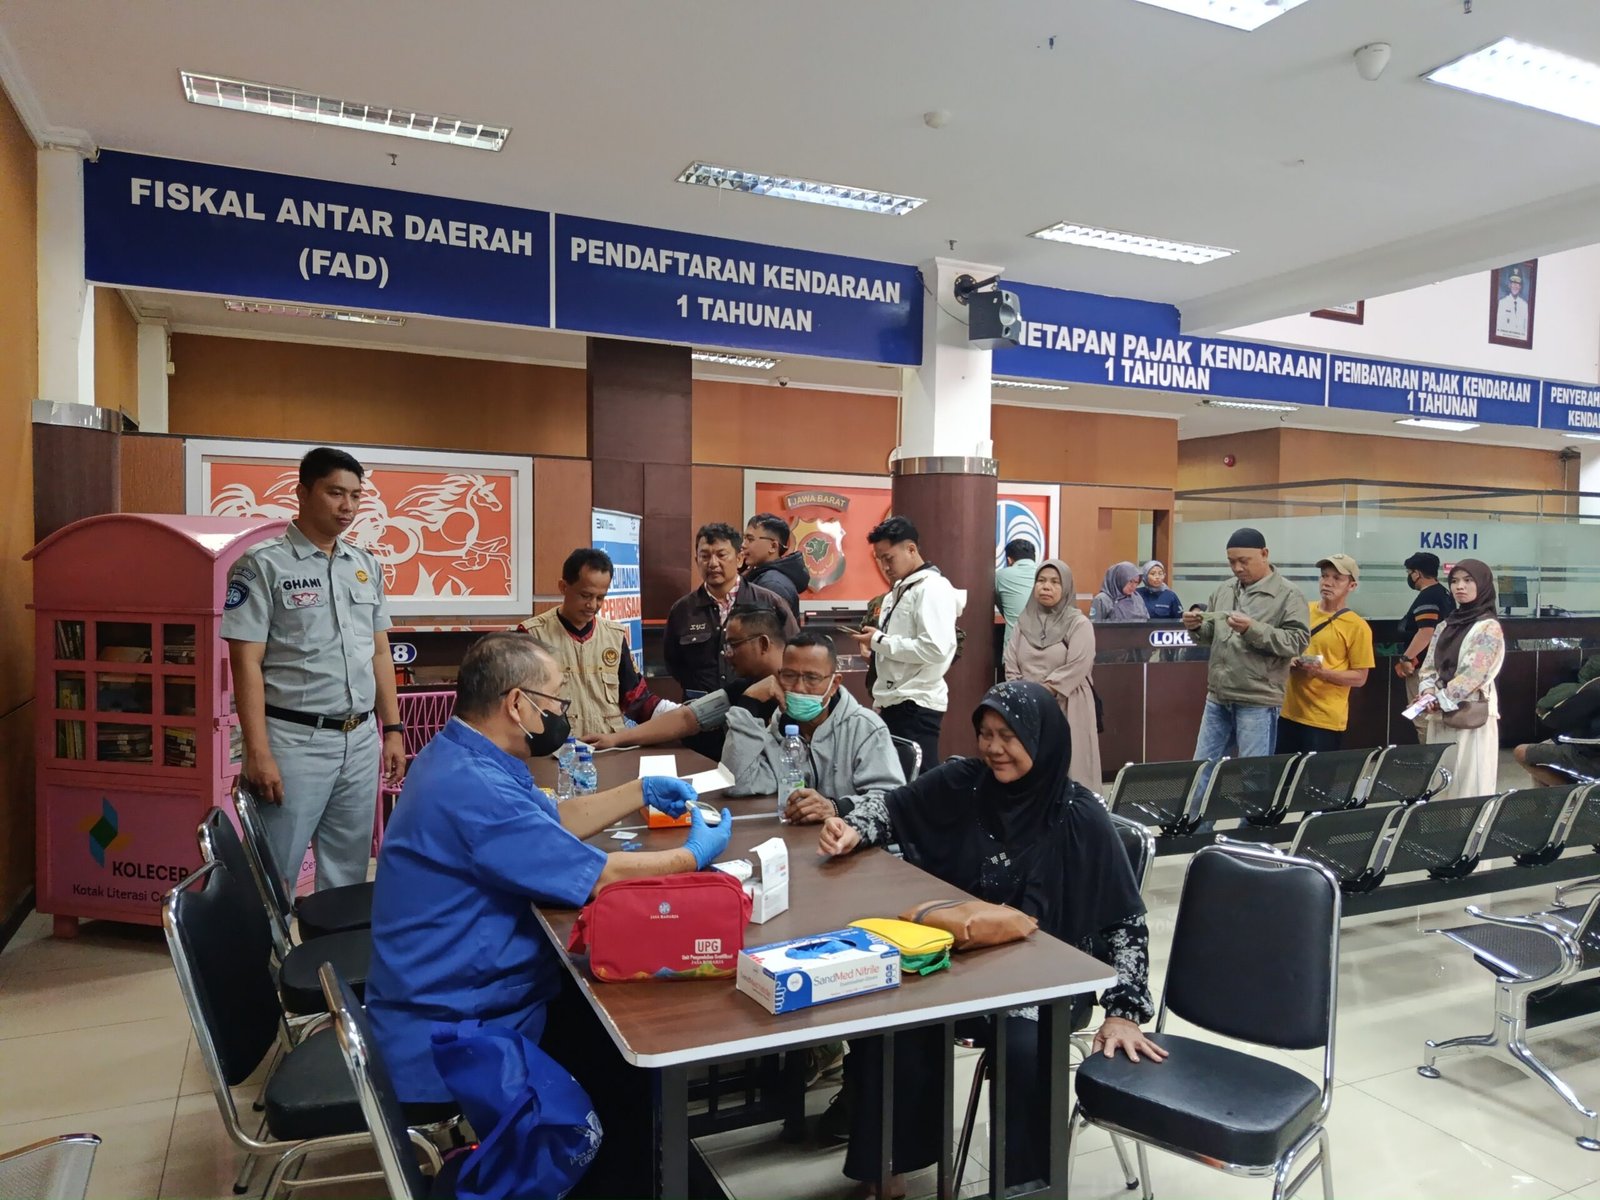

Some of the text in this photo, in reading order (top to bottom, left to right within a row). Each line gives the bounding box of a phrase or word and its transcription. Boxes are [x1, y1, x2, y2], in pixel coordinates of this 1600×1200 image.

[130, 177, 533, 256] FISKAL ANTAR DAERAH
[299, 248, 390, 289] (FAD)
[570, 236, 901, 304] PENDAFTARAN KENDARAAN
[676, 294, 812, 333] 1 TAHUNAN
[1123, 334, 1192, 365] PAJAK
[1200, 343, 1322, 380] KENDARAAN
[1104, 357, 1210, 391] 1 TAHUNAN
[1334, 360, 1531, 403] PEMBAYARAN PAJAK KENDARAAN
[1407, 392, 1478, 418] 1 TAHUNAN
[1568, 409, 1600, 428] KENDA
[792, 494, 846, 508] JAWA BARAT
[1420, 531, 1469, 550] KASIR
[282, 577, 322, 591] GHANI
[392, 644, 409, 663] 8
[72, 883, 104, 897] Kotak
[107, 887, 148, 901] Literasi
[697, 941, 719, 953] UPG
[813, 963, 880, 987] SandMed Nitrile
